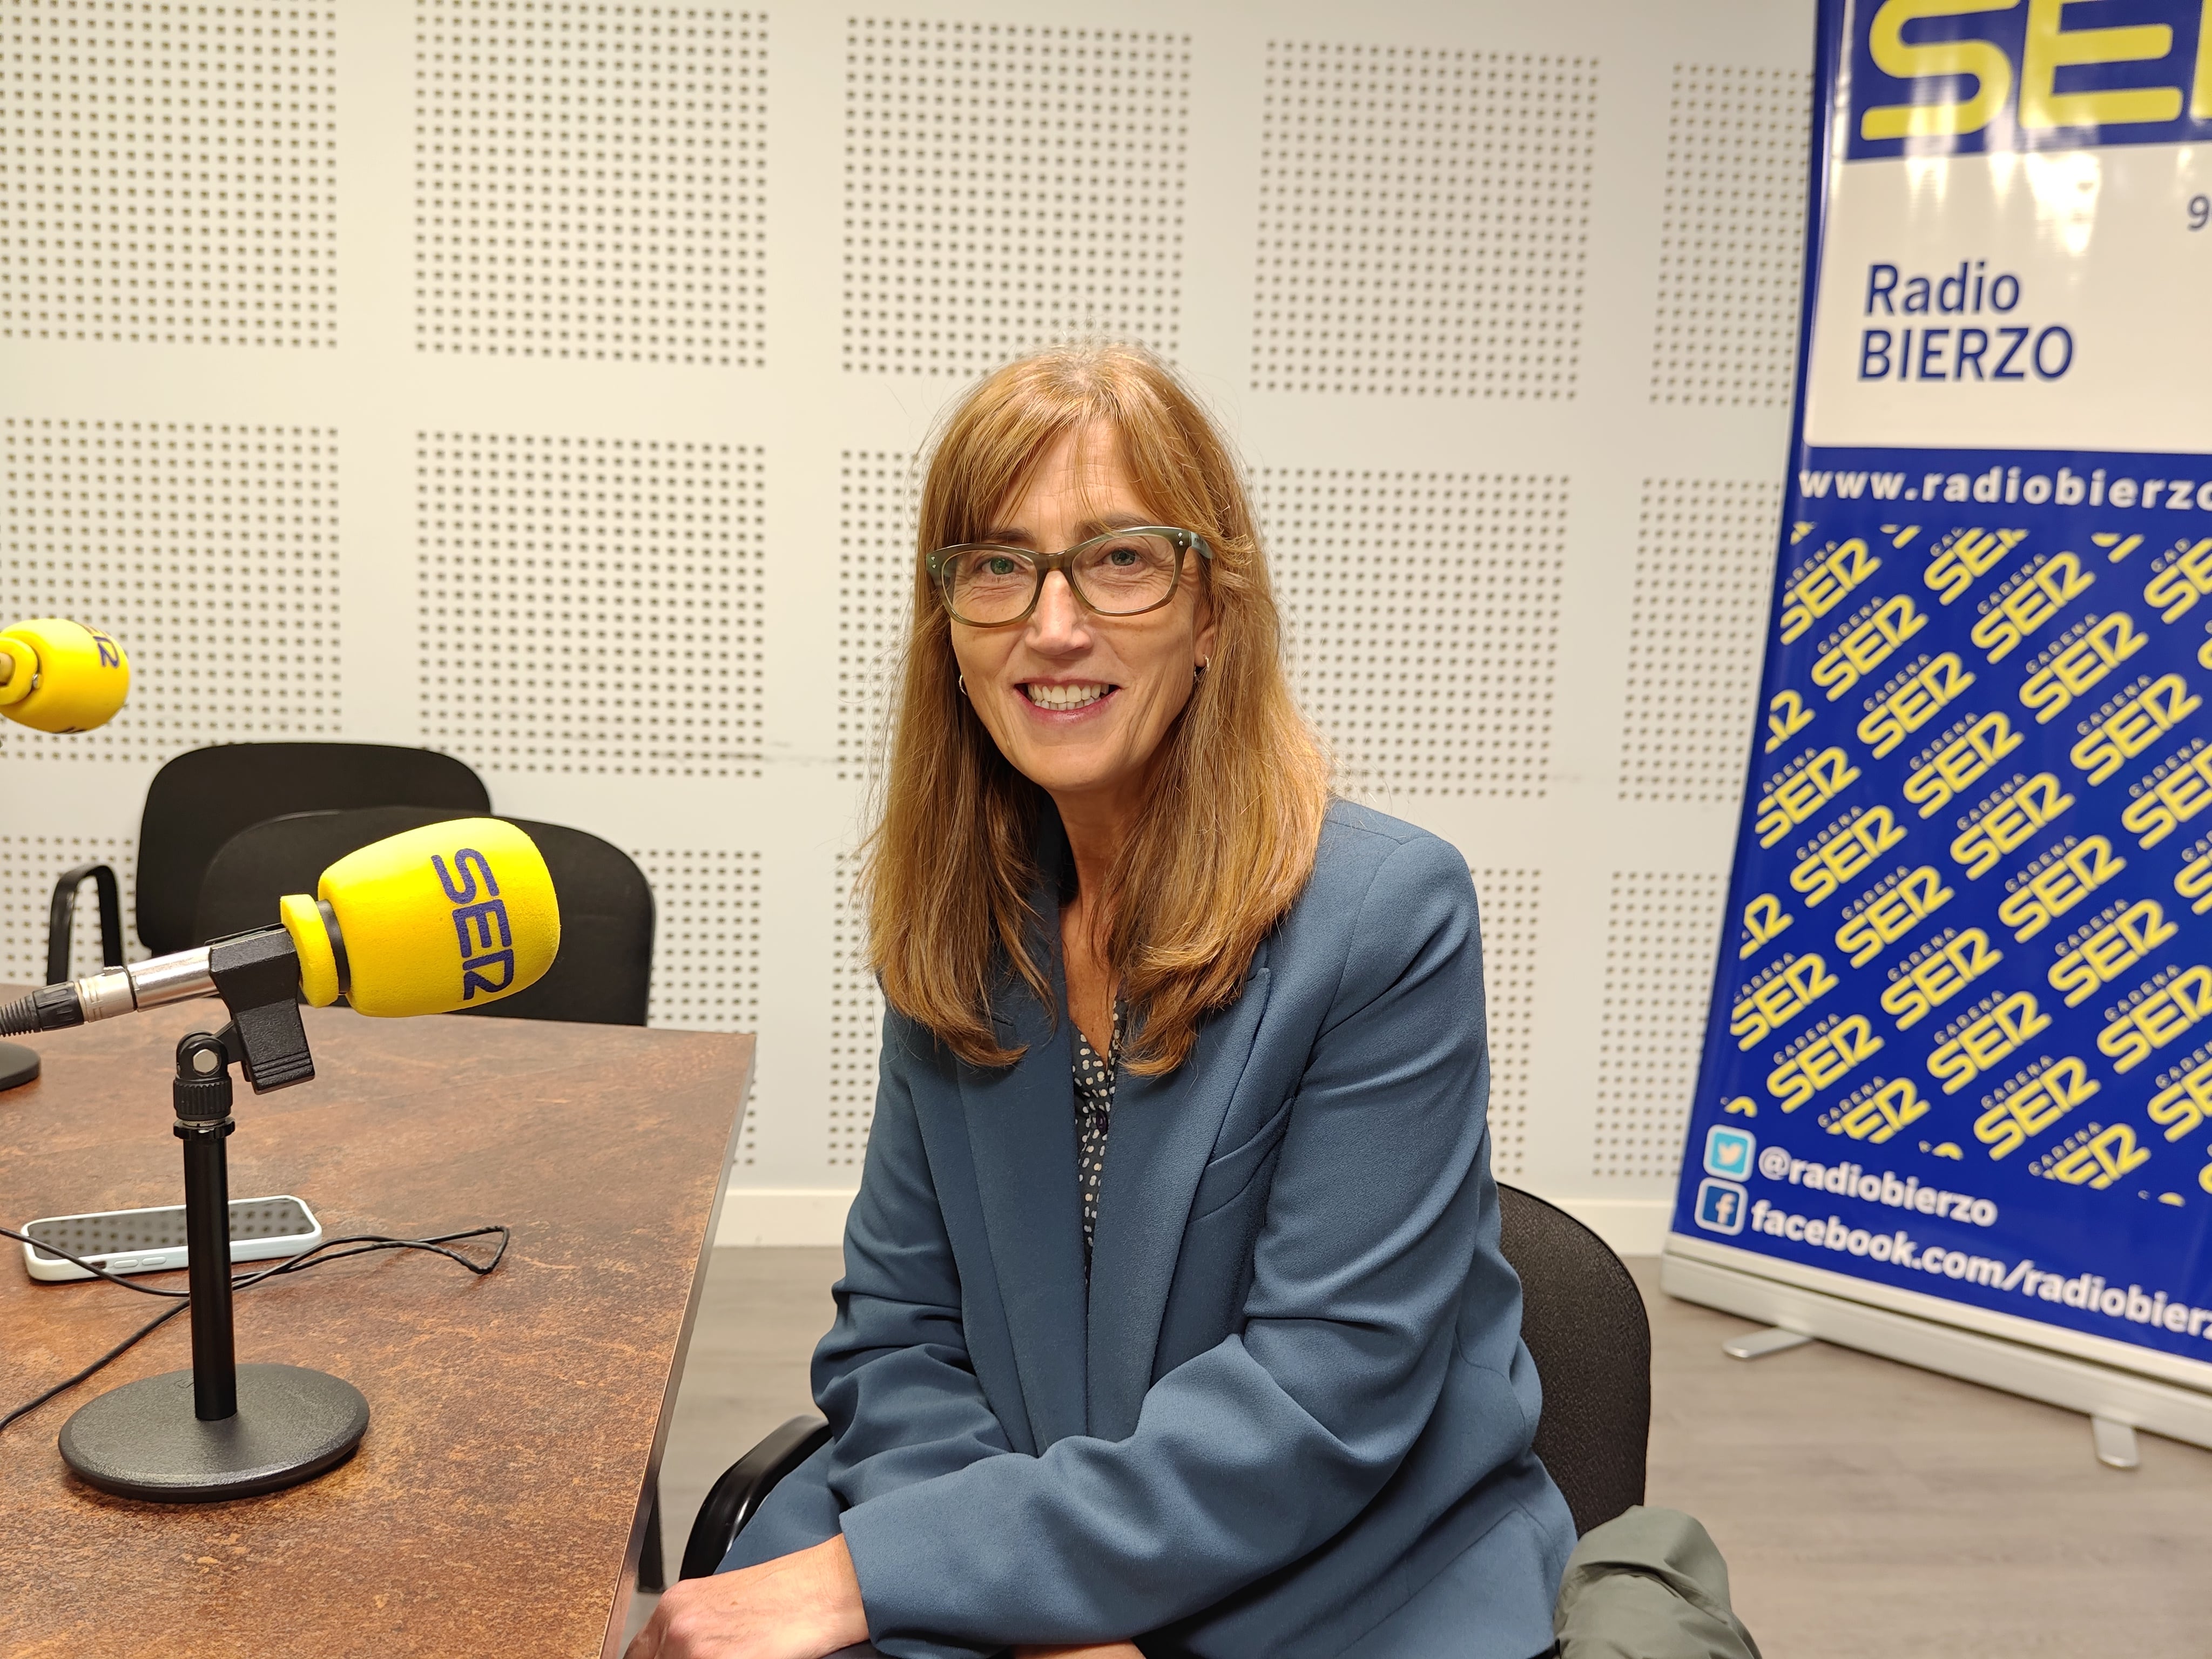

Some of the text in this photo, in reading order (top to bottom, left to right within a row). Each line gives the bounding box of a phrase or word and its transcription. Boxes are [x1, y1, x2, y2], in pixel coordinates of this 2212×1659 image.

[1861, 0, 2212, 141] SE
[1865, 261, 2021, 316] Radio
[1858, 325, 2075, 382] BIERZO
[1971, 552, 2094, 664] SER
[1978, 554, 2048, 615] CADENA
[1811, 595, 1927, 702] SER
[1818, 597, 1885, 655] CADENA
[2026, 613, 2101, 675] CADENA
[1864, 654, 1932, 712] CADENA
[2019, 612, 2148, 724] SER
[1857, 652, 1974, 759] SER
[2070, 674, 2201, 786] SER
[2077, 675, 2153, 736] CADENA
[1903, 712, 2023, 819] SER
[1910, 713, 1979, 771] CADENA
[2129, 738, 2207, 799] CADENA
[1950, 773, 2074, 880] SER
[1957, 773, 2028, 831] CADENA
[1790, 806, 1906, 907] SER
[1797, 806, 1865, 861] CADENA
[2005, 835, 2079, 893] CADENA
[1835, 866, 1953, 968] SER
[1842, 866, 1911, 920] CADENA
[1998, 835, 2125, 943] SER
[431, 848, 515, 1001] SER
[1888, 928, 1958, 982] CADENA
[2048, 900, 2177, 1007] SER
[2055, 899, 2130, 956] CADENA
[1730, 953, 1838, 1051] SER
[1880, 928, 2002, 1030] SER
[2105, 965, 2182, 1022] CADENA
[1773, 1014, 1842, 1065] CADENA
[1926, 992, 2051, 1094] SER
[1934, 991, 2006, 1045] CADENA
[1766, 1015, 1883, 1112] SER
[1981, 1056, 2055, 1110] CADENA
[1818, 1076, 1886, 1128] CADENA
[1973, 1057, 2100, 1160] SER
[2028, 1122, 2103, 1177] CADENA
[1758, 1145, 1999, 1228] @radiobierzo
